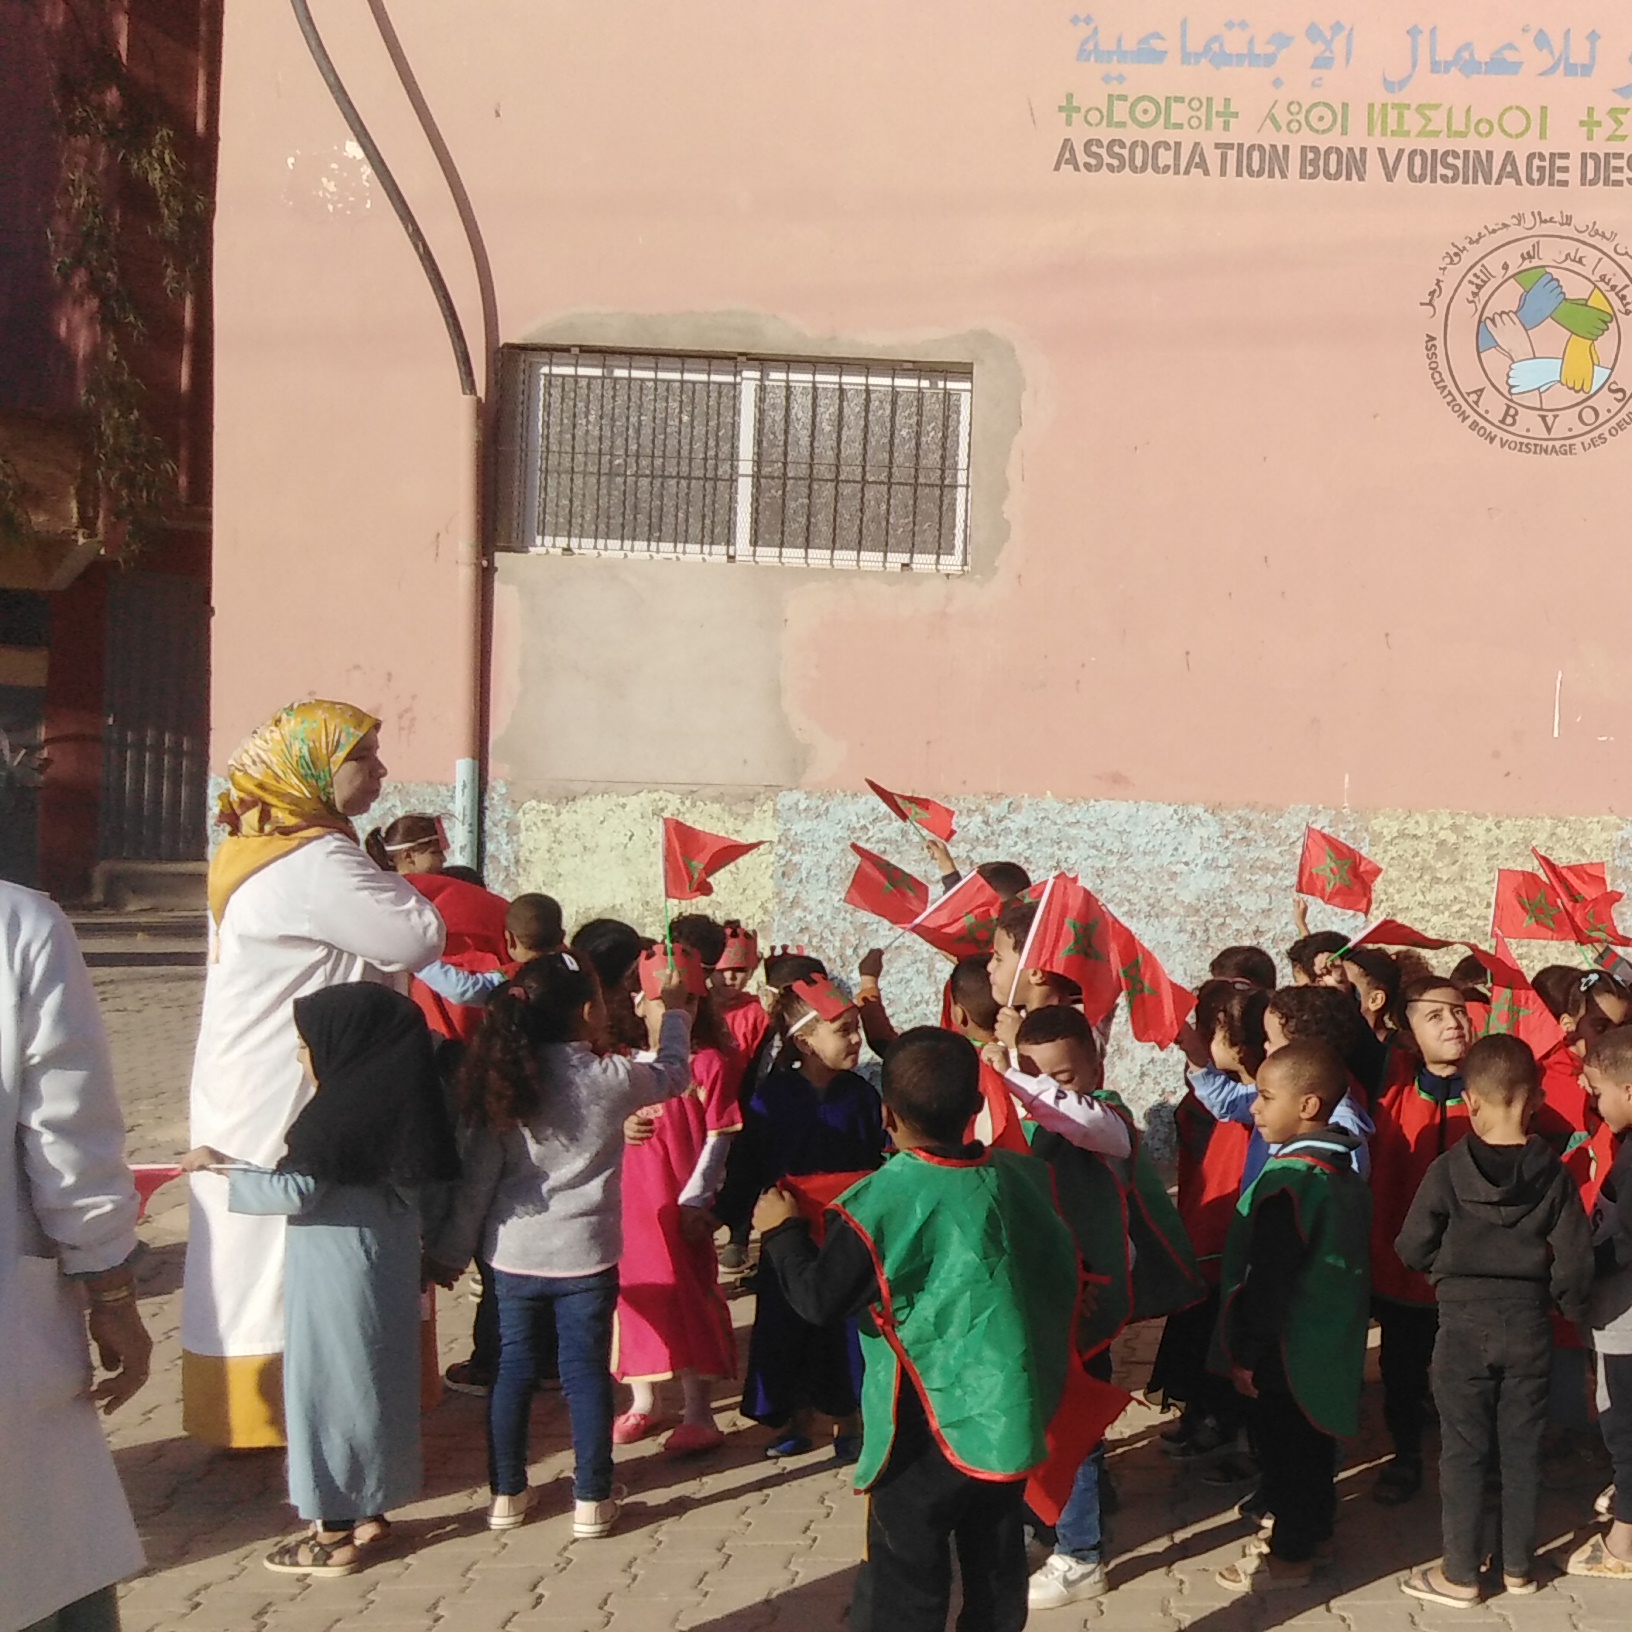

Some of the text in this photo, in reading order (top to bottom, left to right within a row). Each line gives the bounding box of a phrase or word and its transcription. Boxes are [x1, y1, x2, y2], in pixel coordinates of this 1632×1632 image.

[1069, 14, 1354, 89] الإجتماعية
[1053, 138, 1290, 180] ASSOCIATION
[1299, 145, 1368, 182] BON
[1377, 147, 1570, 187] VOISINAGE
[1573, 220, 1618, 243] الجوار
[1517, 240, 1543, 269] البر
[1552, 248, 1587, 268] على
[1425, 333, 1471, 424] ASSOCIATION
[1468, 419, 1498, 445] BON
[1499, 437, 1577, 456] VOISINAGE
